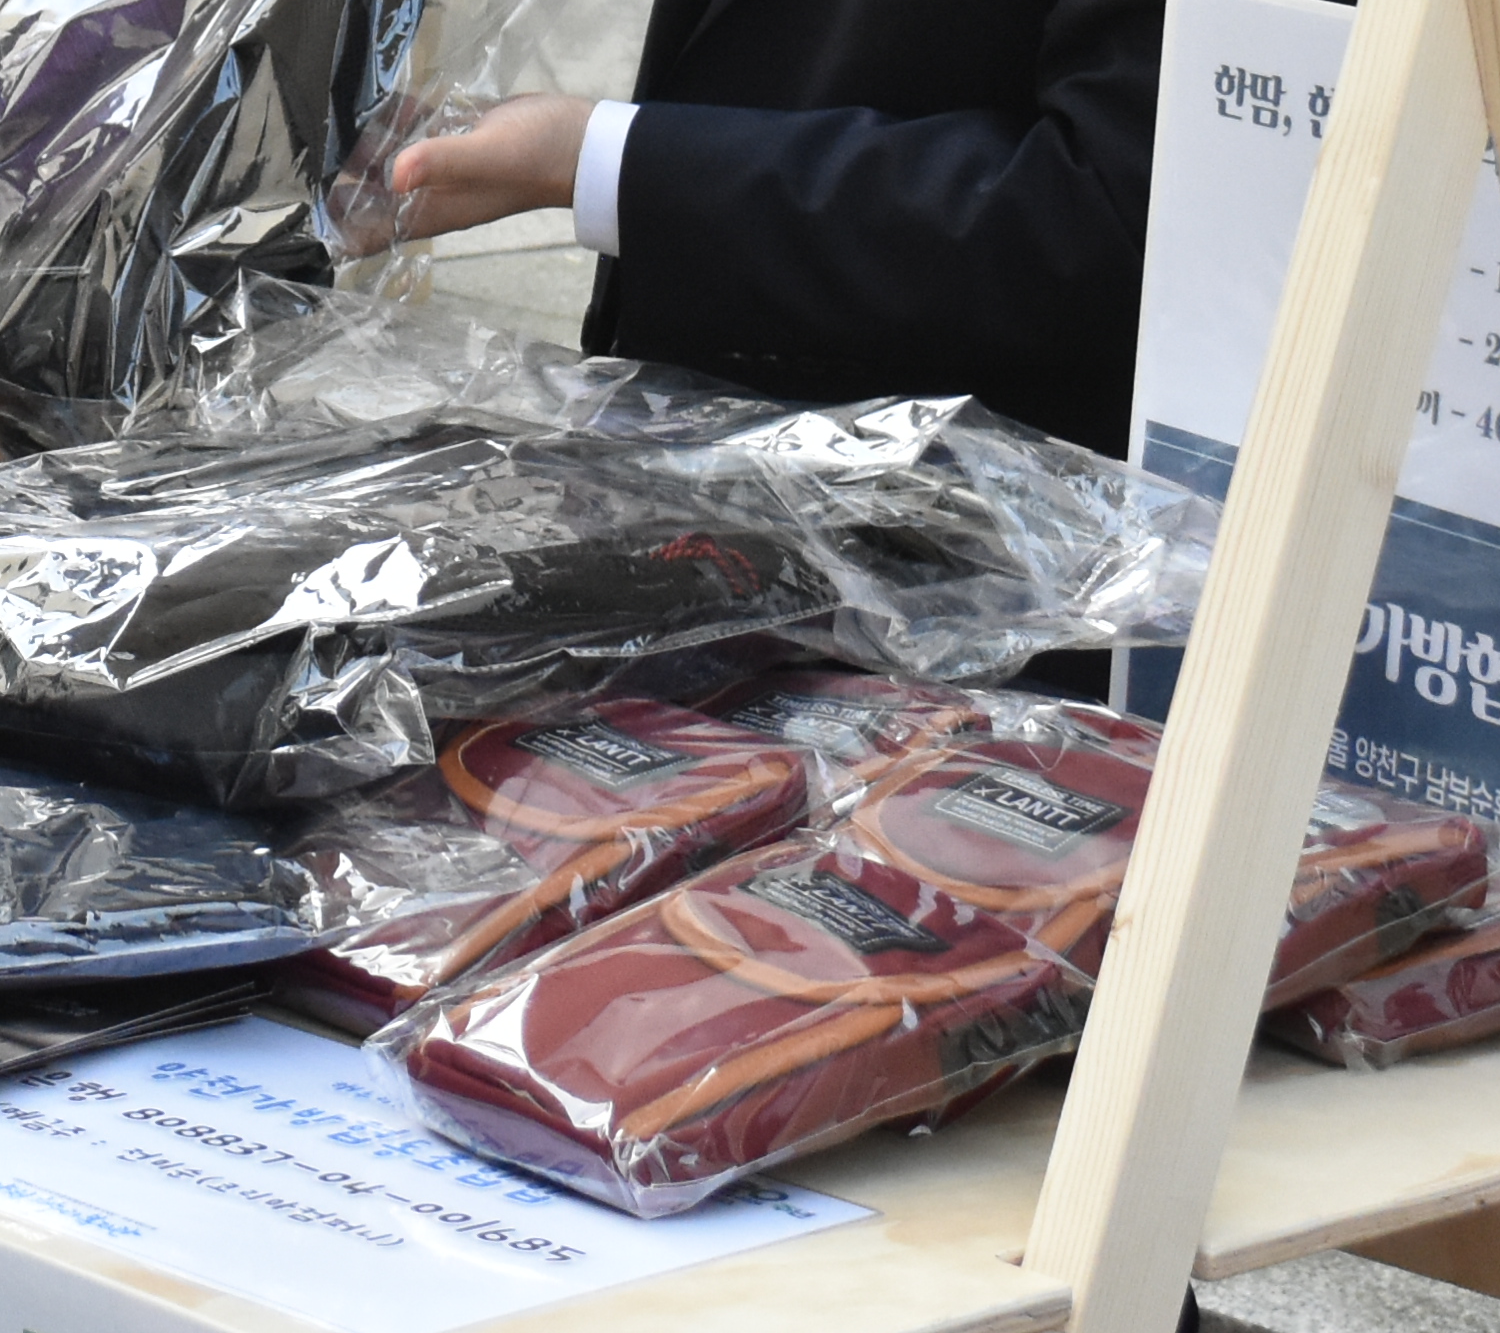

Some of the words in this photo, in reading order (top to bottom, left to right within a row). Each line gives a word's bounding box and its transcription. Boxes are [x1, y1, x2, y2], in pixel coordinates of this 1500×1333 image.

[1214, 64, 1293, 137] 한땀,
[575, 735, 652, 766] LANTT
[1326, 727, 1349, 770] 울
[1355, 736, 1419, 793] 양천구
[995, 790, 1082, 827] LANTT
[18, 1070, 128, 1102] 은행
[121, 1107, 587, 1264] 808837-04-001685
